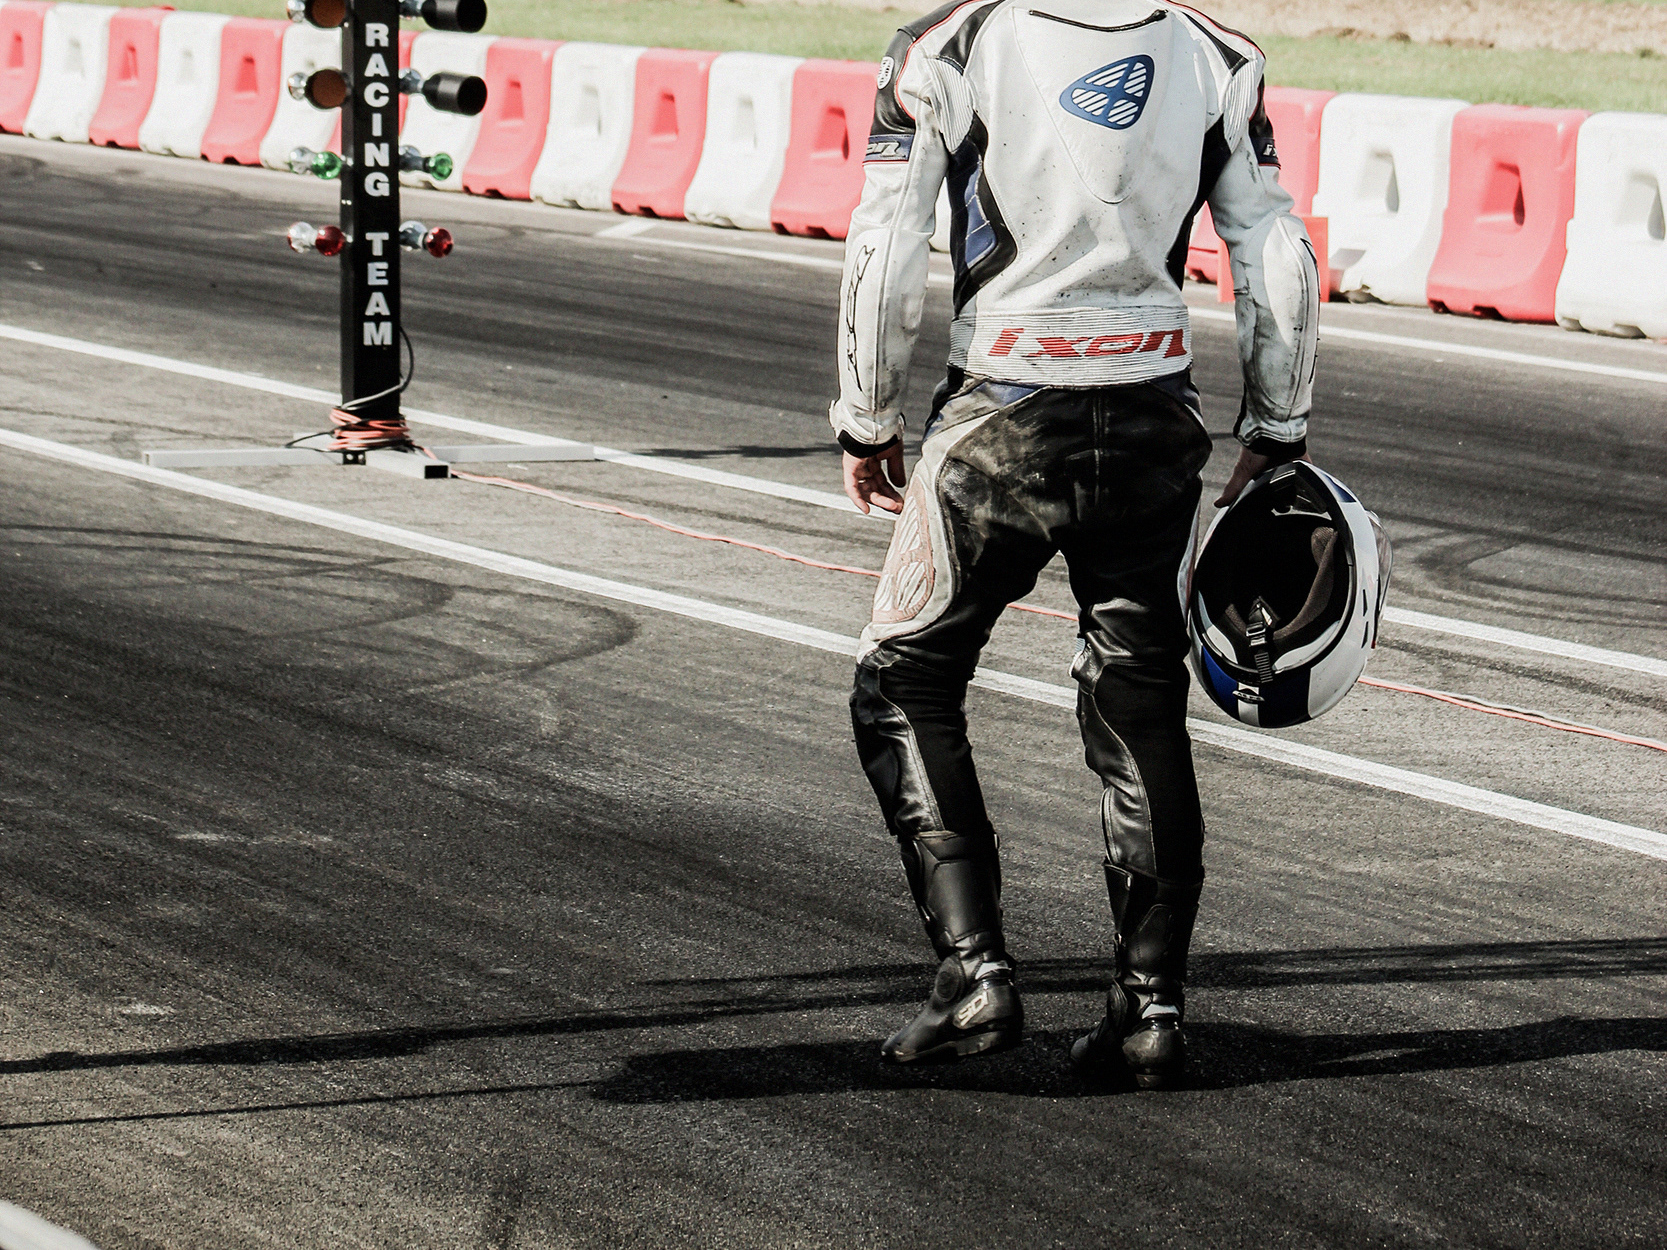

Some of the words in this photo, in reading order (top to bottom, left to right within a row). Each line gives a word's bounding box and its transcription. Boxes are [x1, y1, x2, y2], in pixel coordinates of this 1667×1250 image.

[363, 22, 390, 197] RACING
[363, 232, 392, 346] TEAM
[987, 327, 1188, 358] ixon
